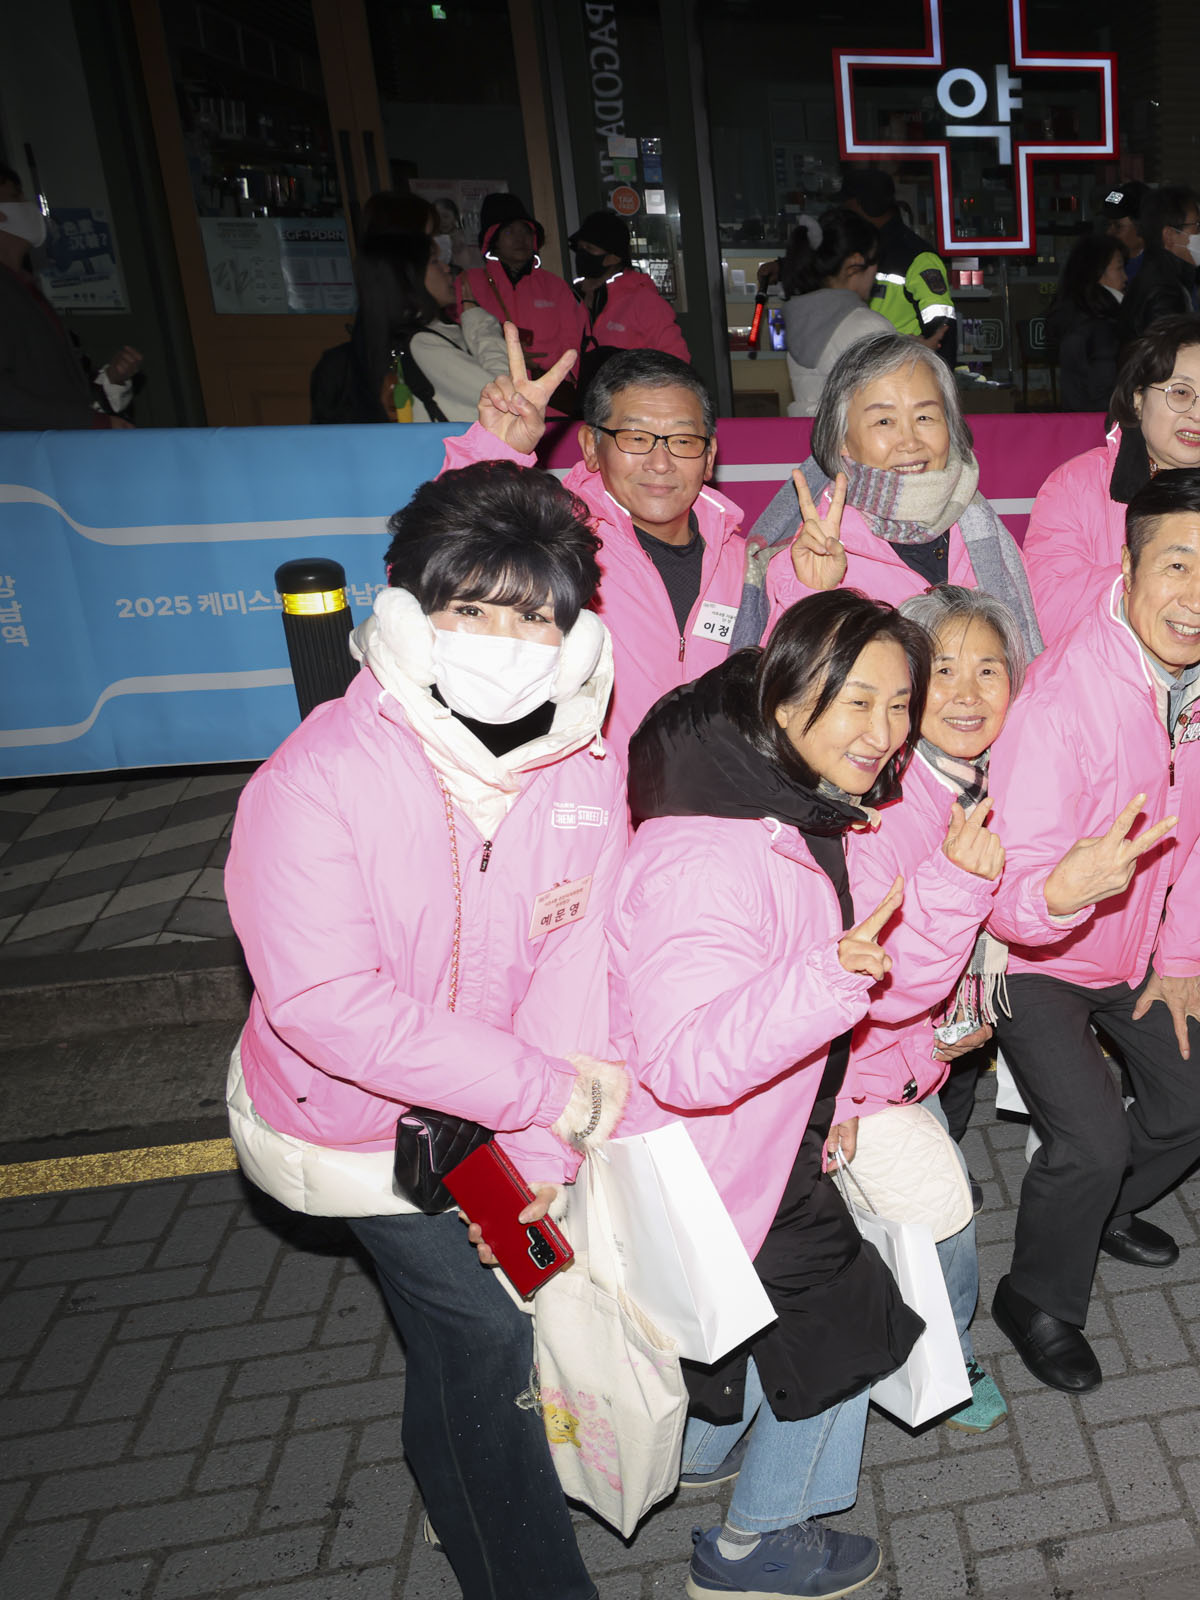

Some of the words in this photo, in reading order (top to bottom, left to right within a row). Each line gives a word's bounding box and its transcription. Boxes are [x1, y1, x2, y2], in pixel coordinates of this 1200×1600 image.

[936, 64, 1023, 166] 약
[115, 595, 192, 618] 2025
[703, 622, 730, 637] 이정
